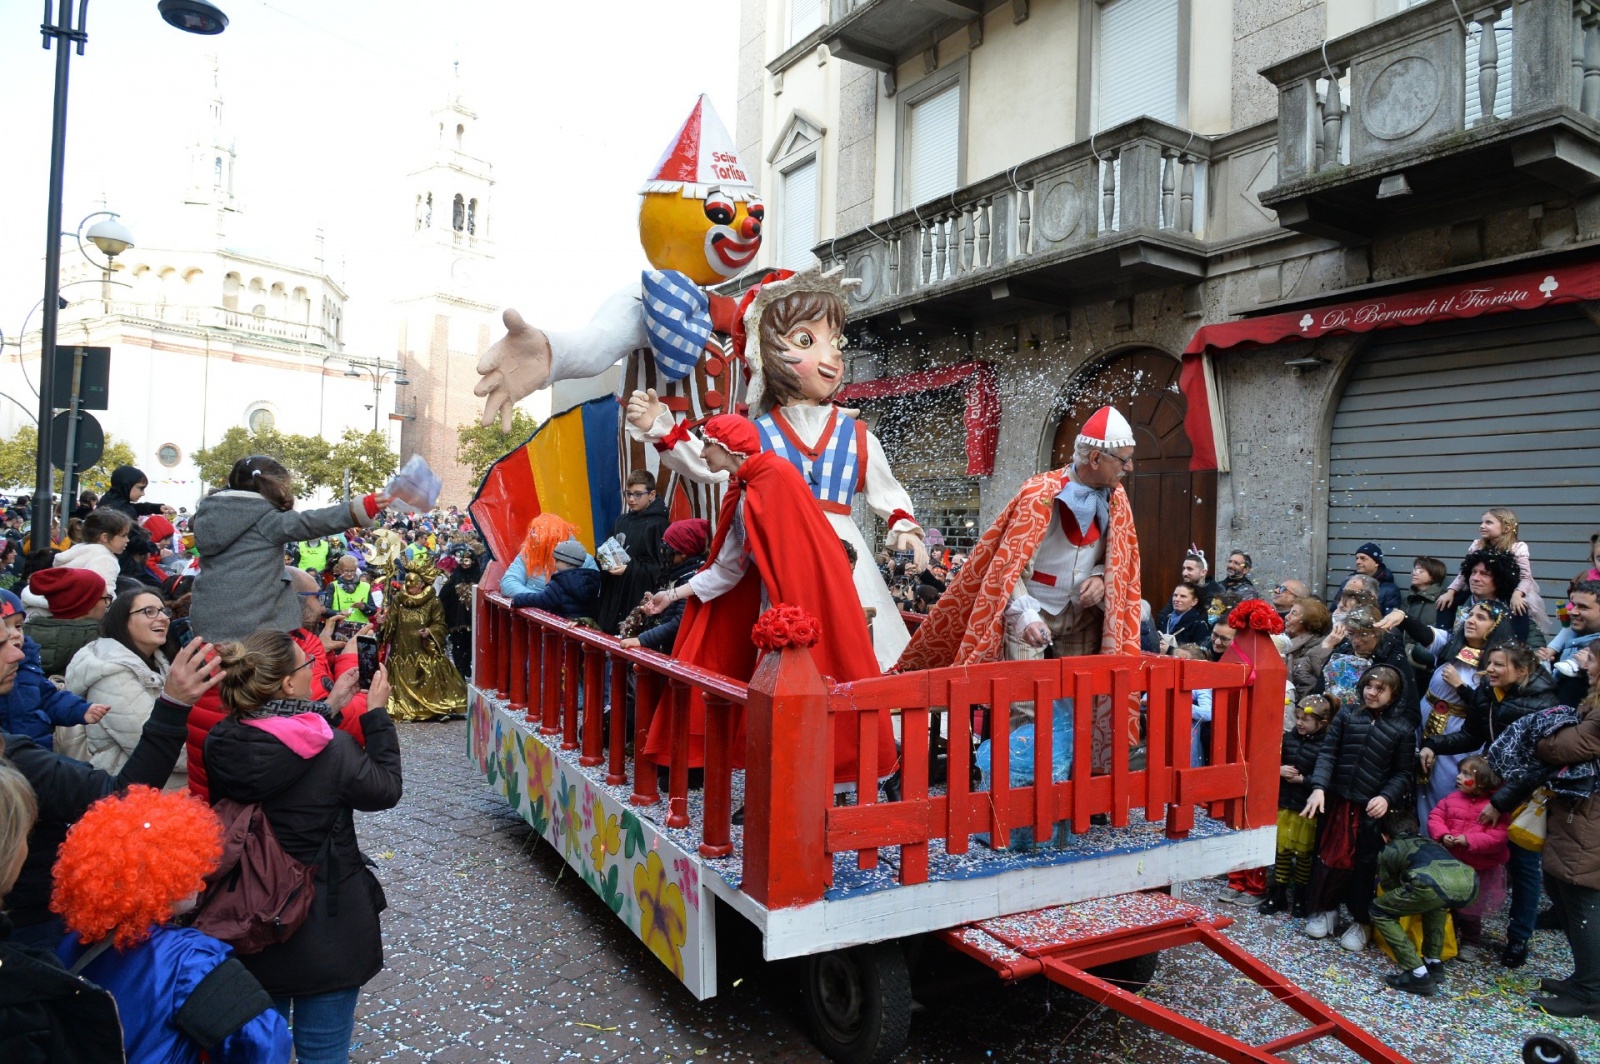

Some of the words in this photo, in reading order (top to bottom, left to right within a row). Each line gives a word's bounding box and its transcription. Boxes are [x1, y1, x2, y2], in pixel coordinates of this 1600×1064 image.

[712, 151, 737, 164] Sciur
[710, 164, 747, 182] Tarlisu
[1320, 308, 1353, 329] De
[1354, 299, 1438, 325] Bernardi
[1439, 296, 1455, 313] il
[1455, 287, 1530, 311] Fiorista
